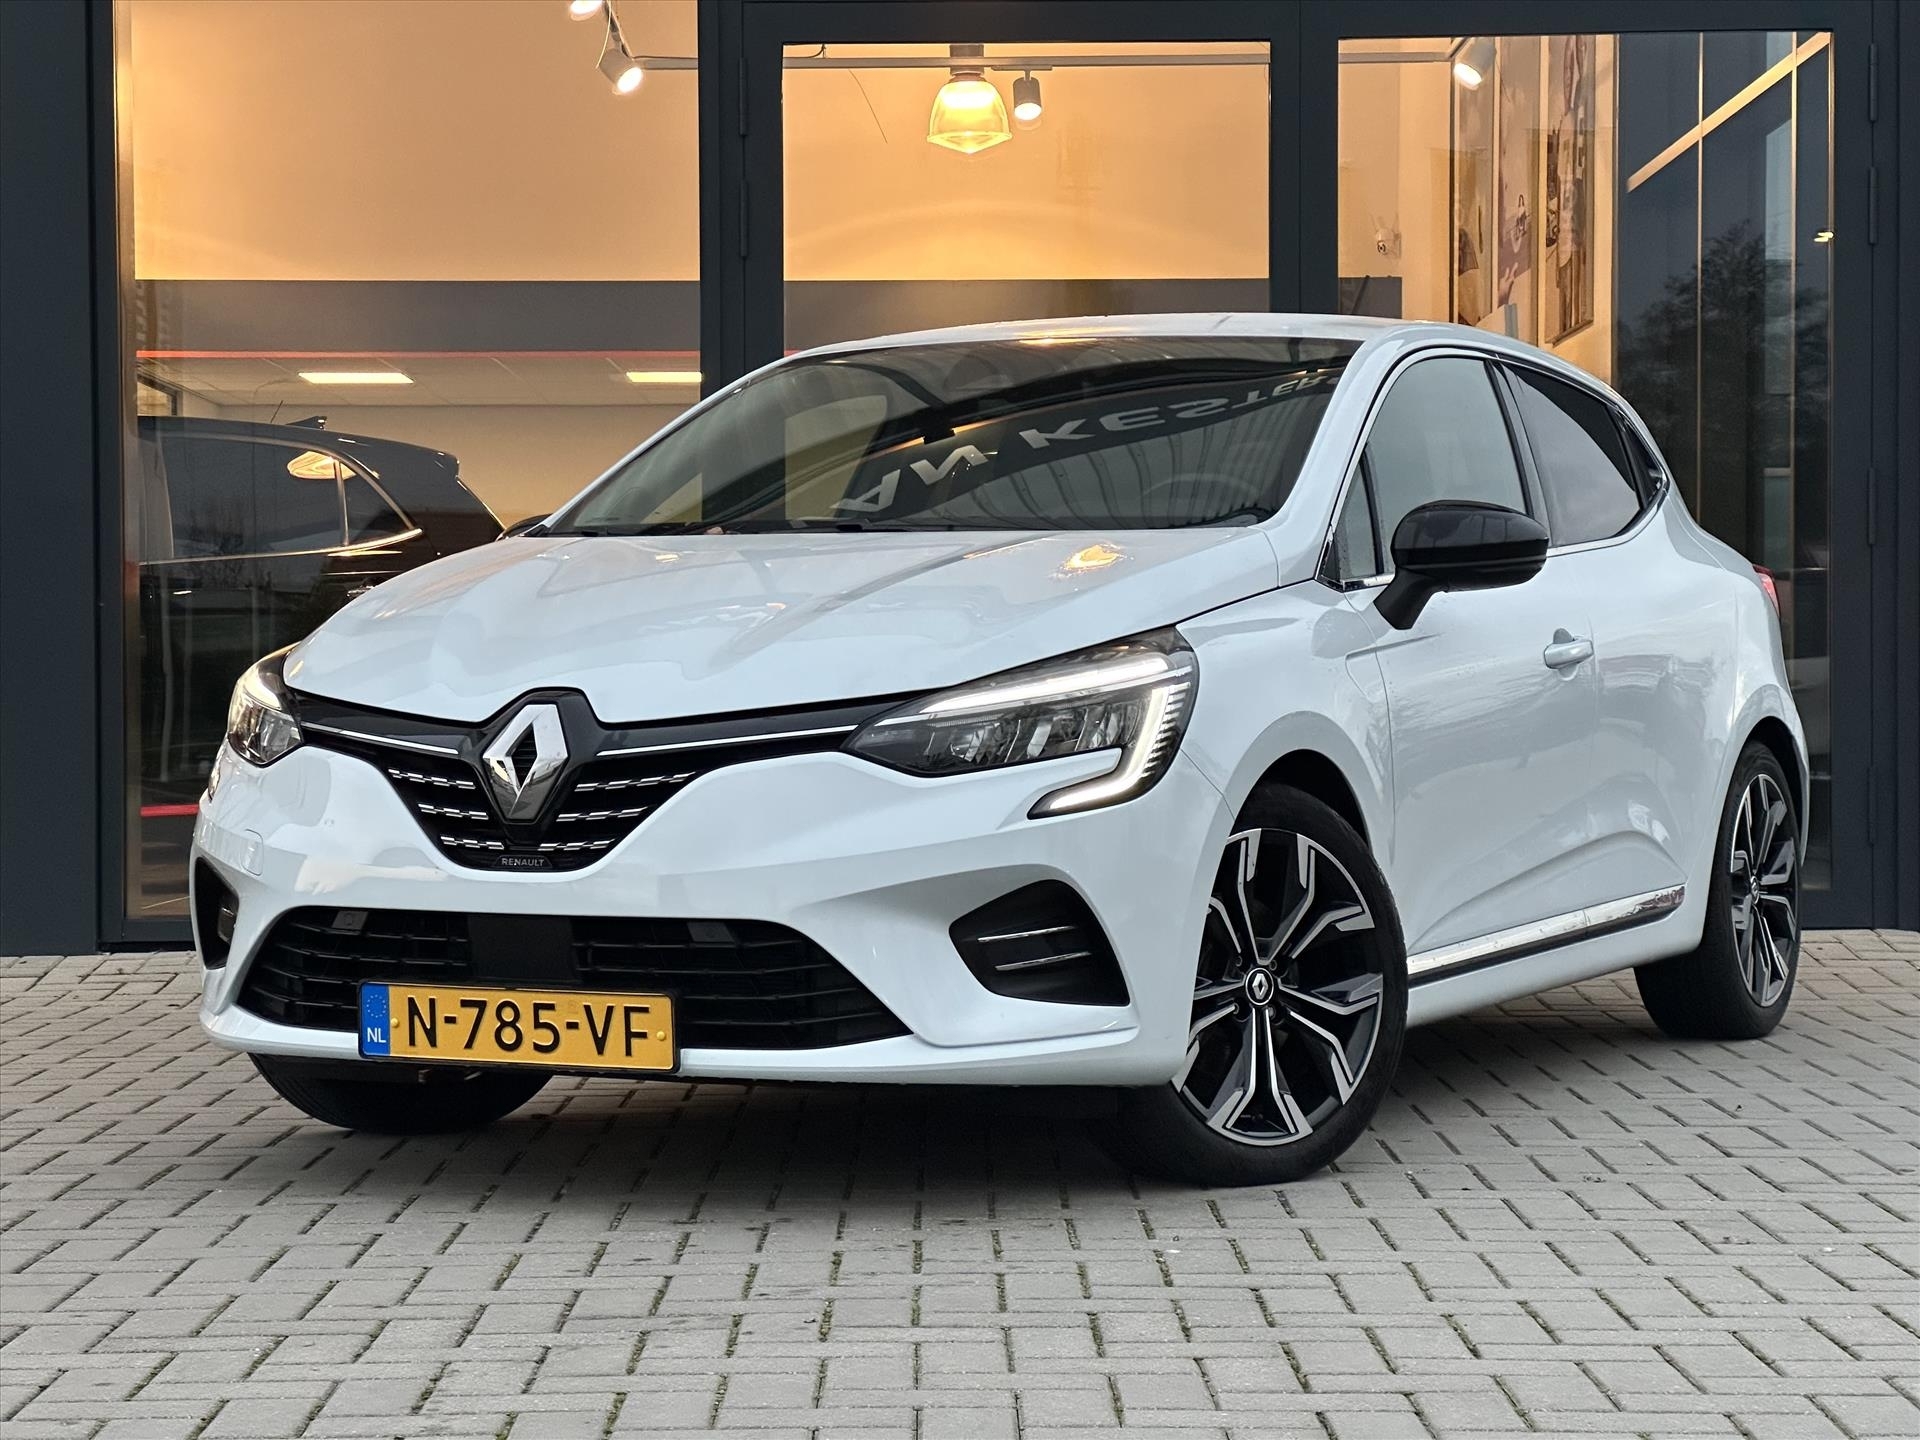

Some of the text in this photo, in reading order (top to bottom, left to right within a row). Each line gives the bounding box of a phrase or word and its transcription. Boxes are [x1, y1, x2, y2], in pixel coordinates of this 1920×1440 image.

[501, 857, 545, 867] RENAULT
[407, 996, 650, 1057] N-785-VF
[367, 1027, 386, 1043] NL
